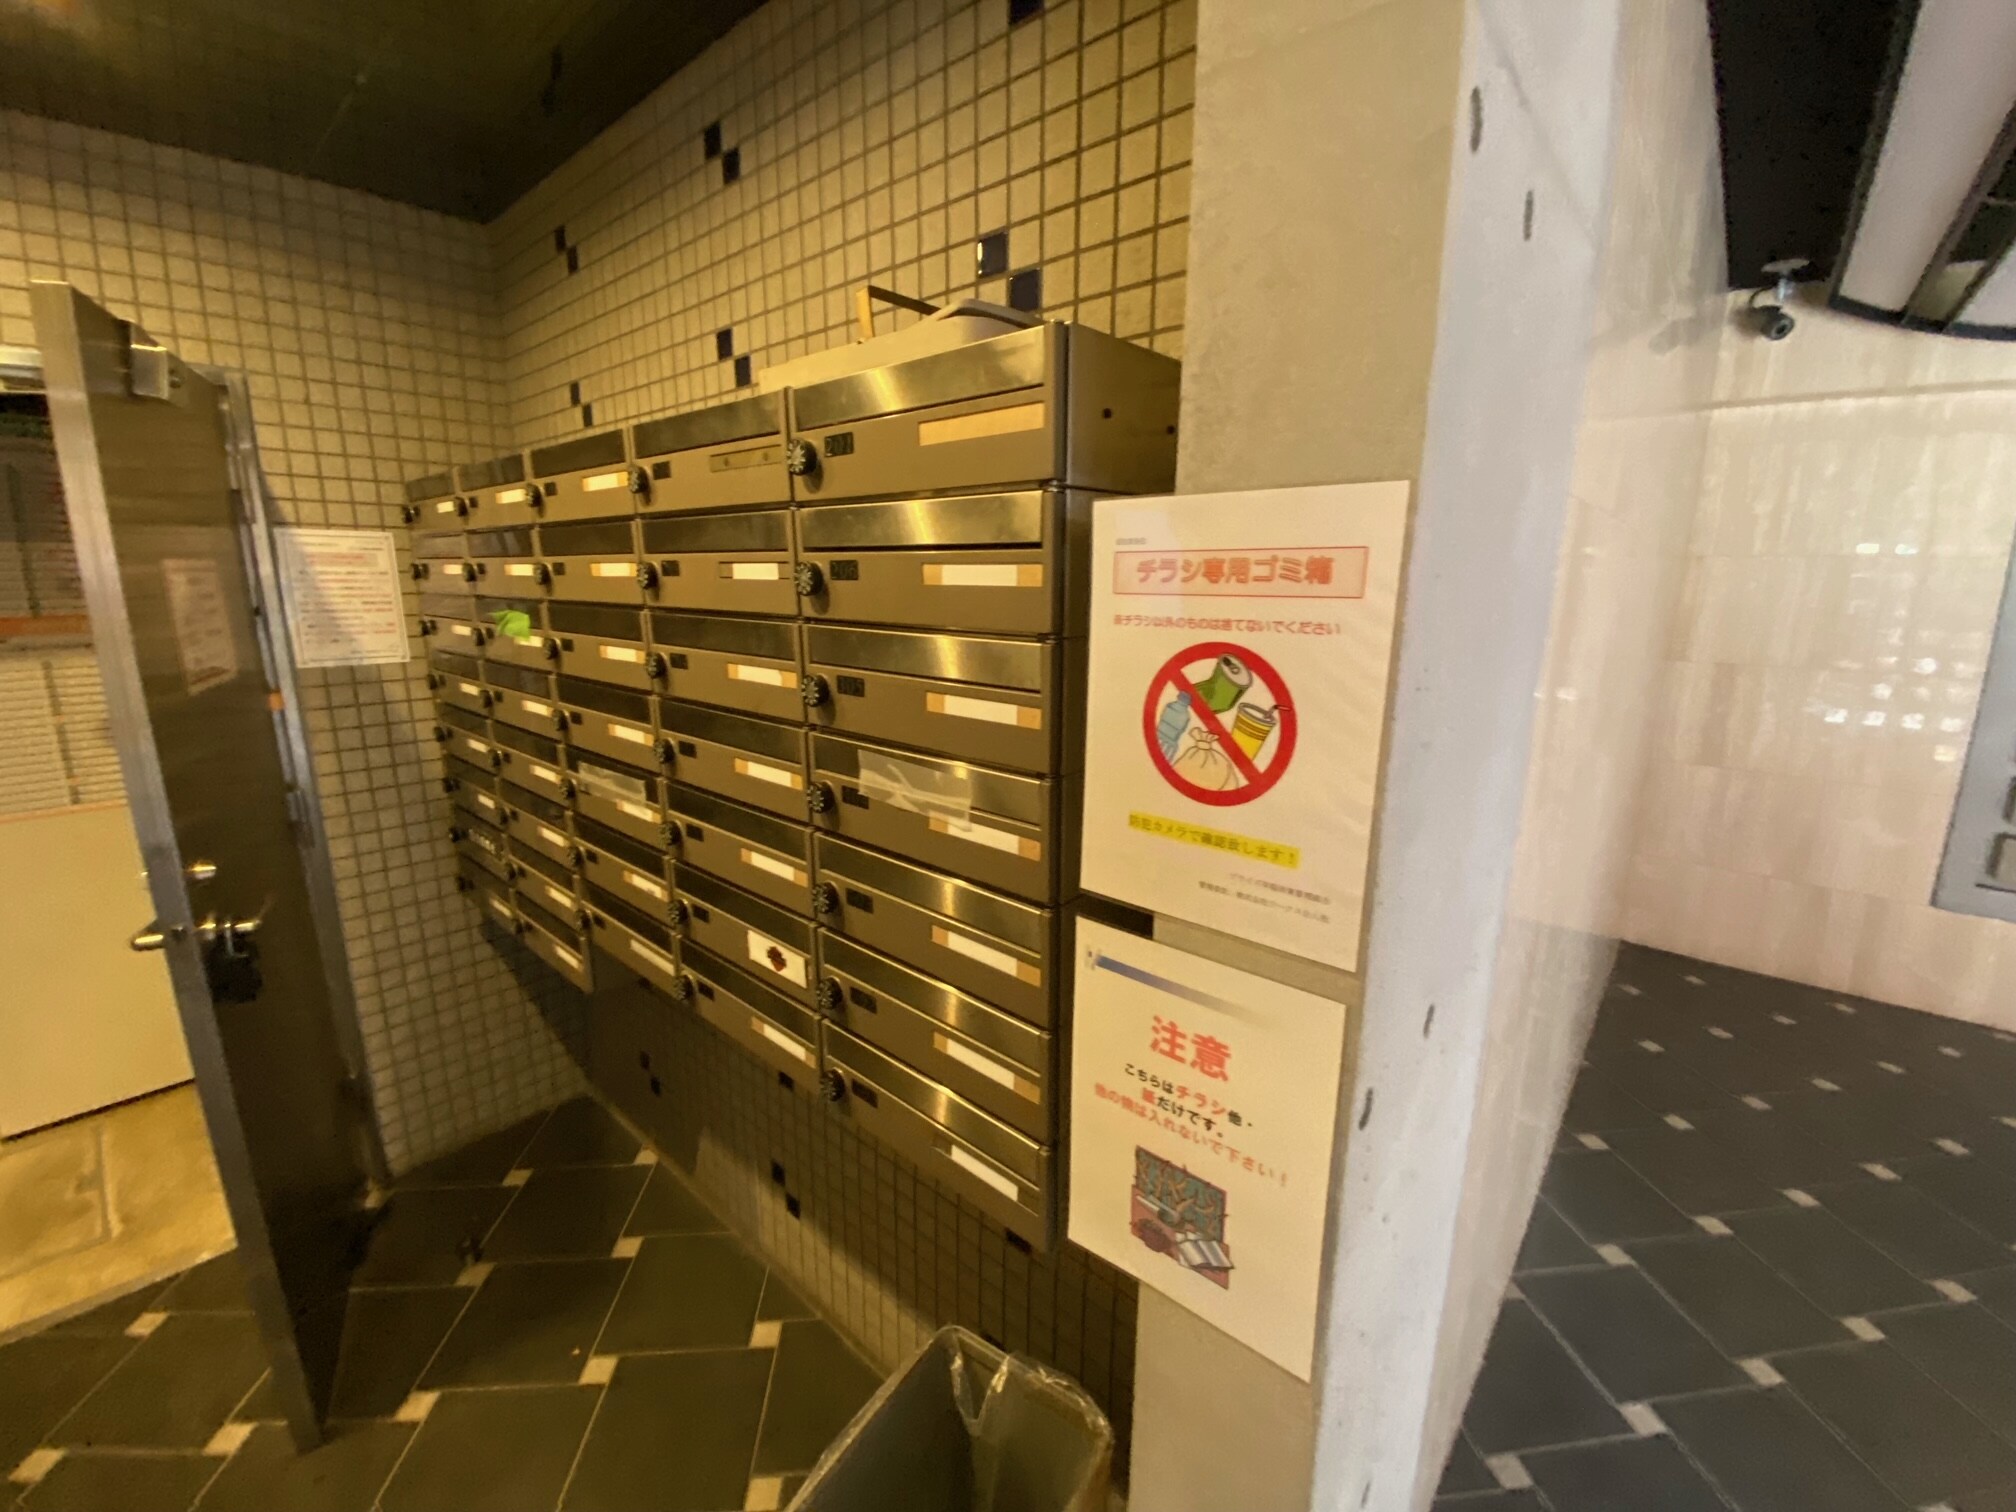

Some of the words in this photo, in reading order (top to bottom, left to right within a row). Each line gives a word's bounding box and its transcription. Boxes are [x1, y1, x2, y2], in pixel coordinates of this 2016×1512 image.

[1136, 554, 1335, 585] チラシ専用ゴミ箱
[1149, 1014, 1231, 1082] 注意
